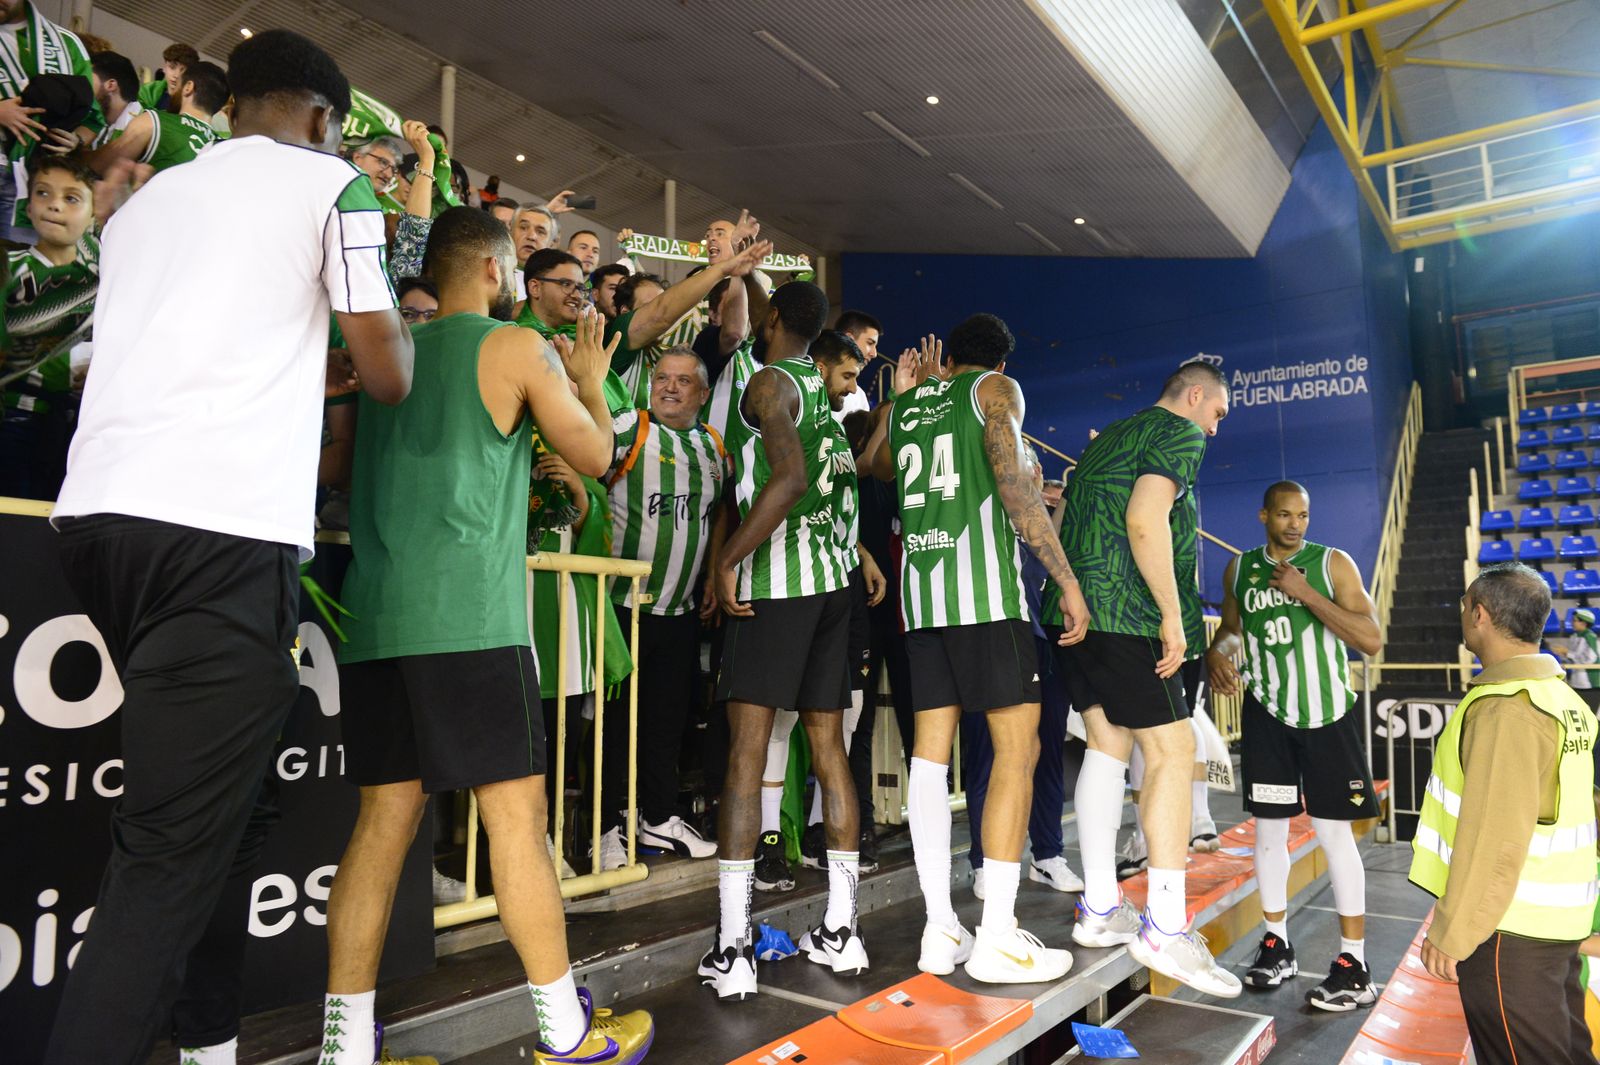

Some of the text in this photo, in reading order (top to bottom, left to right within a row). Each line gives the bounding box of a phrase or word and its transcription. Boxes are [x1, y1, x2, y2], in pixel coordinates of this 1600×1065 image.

[1232, 354, 1368, 389] Ayuntamiento de
[1232, 376, 1368, 407] FUENLABRADA
[898, 432, 960, 510] 24
[648, 492, 698, 530] BETIS
[1264, 616, 1293, 646] 30
